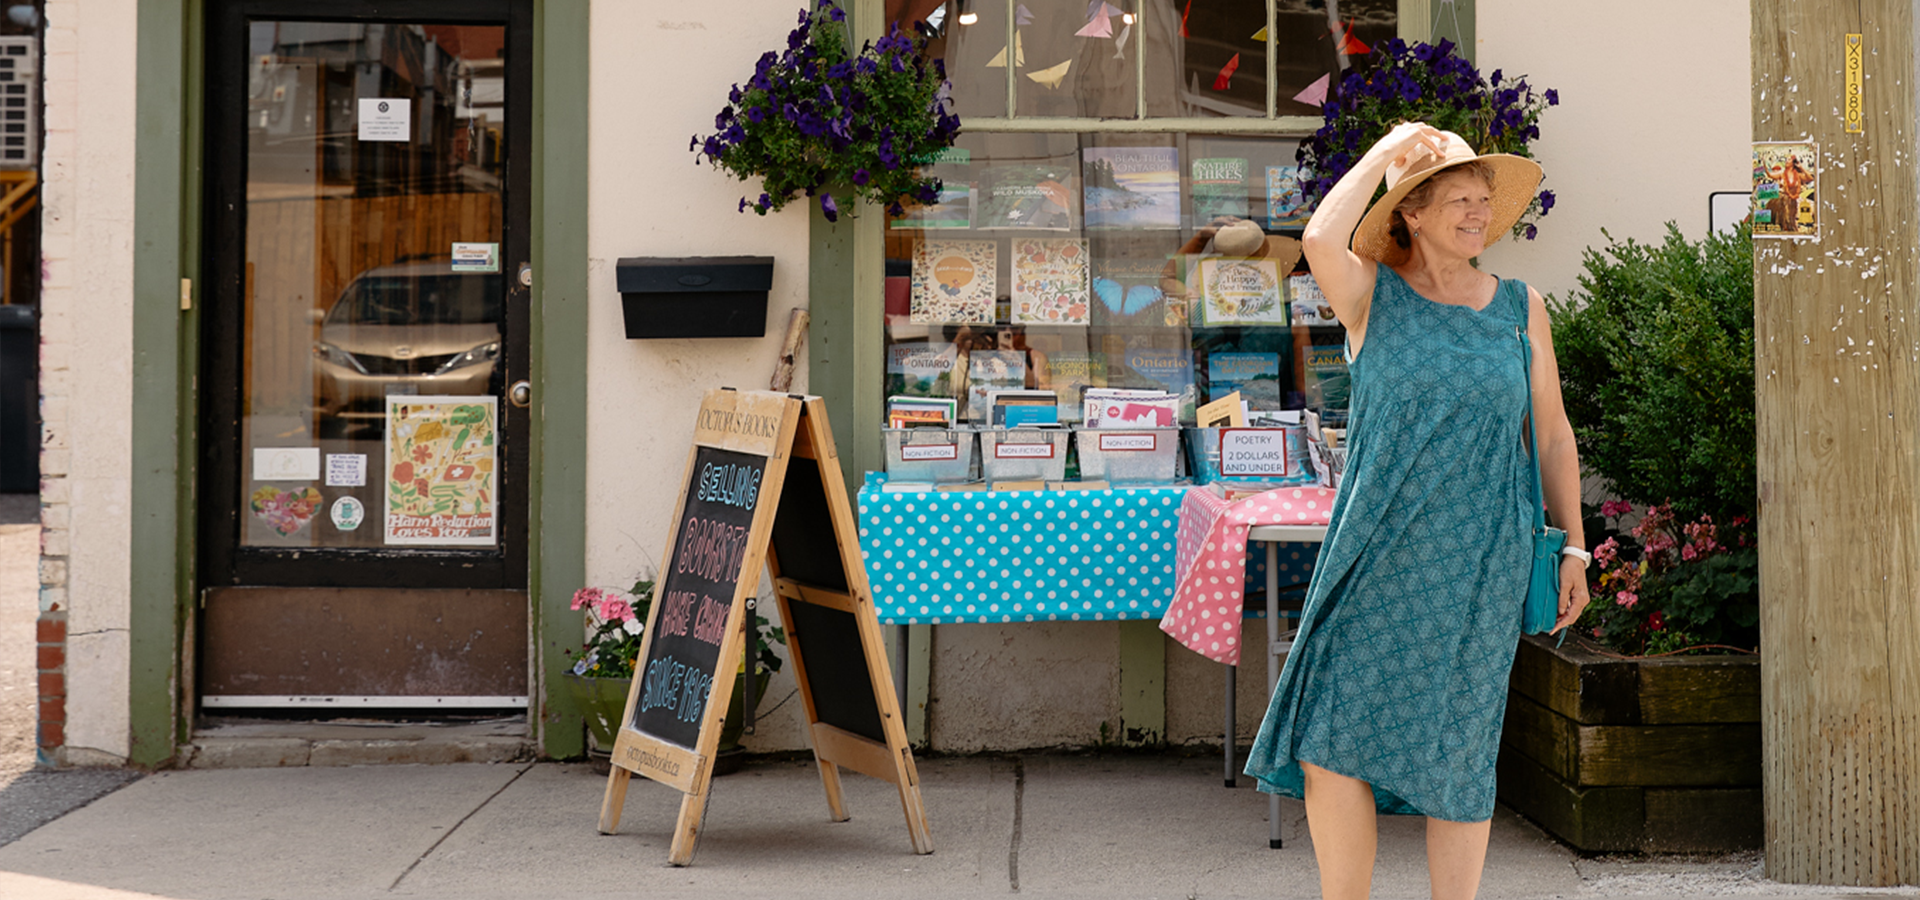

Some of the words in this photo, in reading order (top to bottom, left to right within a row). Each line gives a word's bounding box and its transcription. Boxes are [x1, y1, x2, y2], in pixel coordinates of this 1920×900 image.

[1848, 44, 1860, 122] X31380
[1115, 154, 1171, 163] BEAUTIFUL
[1117, 164, 1169, 173] ONTARIO
[1199, 162, 1241, 171] NATURE
[1199, 169, 1243, 180] HIKES
[1233, 268, 1248, 276] Bee
[1226, 275, 1258, 285] Happy
[895, 348, 911, 357] TOP
[911, 359, 950, 368] ONTARIO
[1045, 362, 1101, 370] ALGONQUIN
[1132, 356, 1188, 367] Ontario
[701, 409, 742, 433] OCTOPUS
[742, 414, 777, 438] BOOKS
[1235, 436, 1272, 445] POETRY
[1228, 452, 1235, 460] 2
[1236, 452, 1279, 460] DOLLARS
[1225, 464, 1247, 472] AND
[1249, 463, 1283, 472] UNDER
[698, 462, 760, 510] SELLING
[388, 514, 430, 527] Harm
[430, 513, 492, 527] Reduction
[388, 527, 433, 537] Loves
[439, 527, 470, 537] You.
[679, 516, 733, 583] BOOKS
[660, 590, 697, 638] MAKE
[641, 655, 686, 712] SINCE
